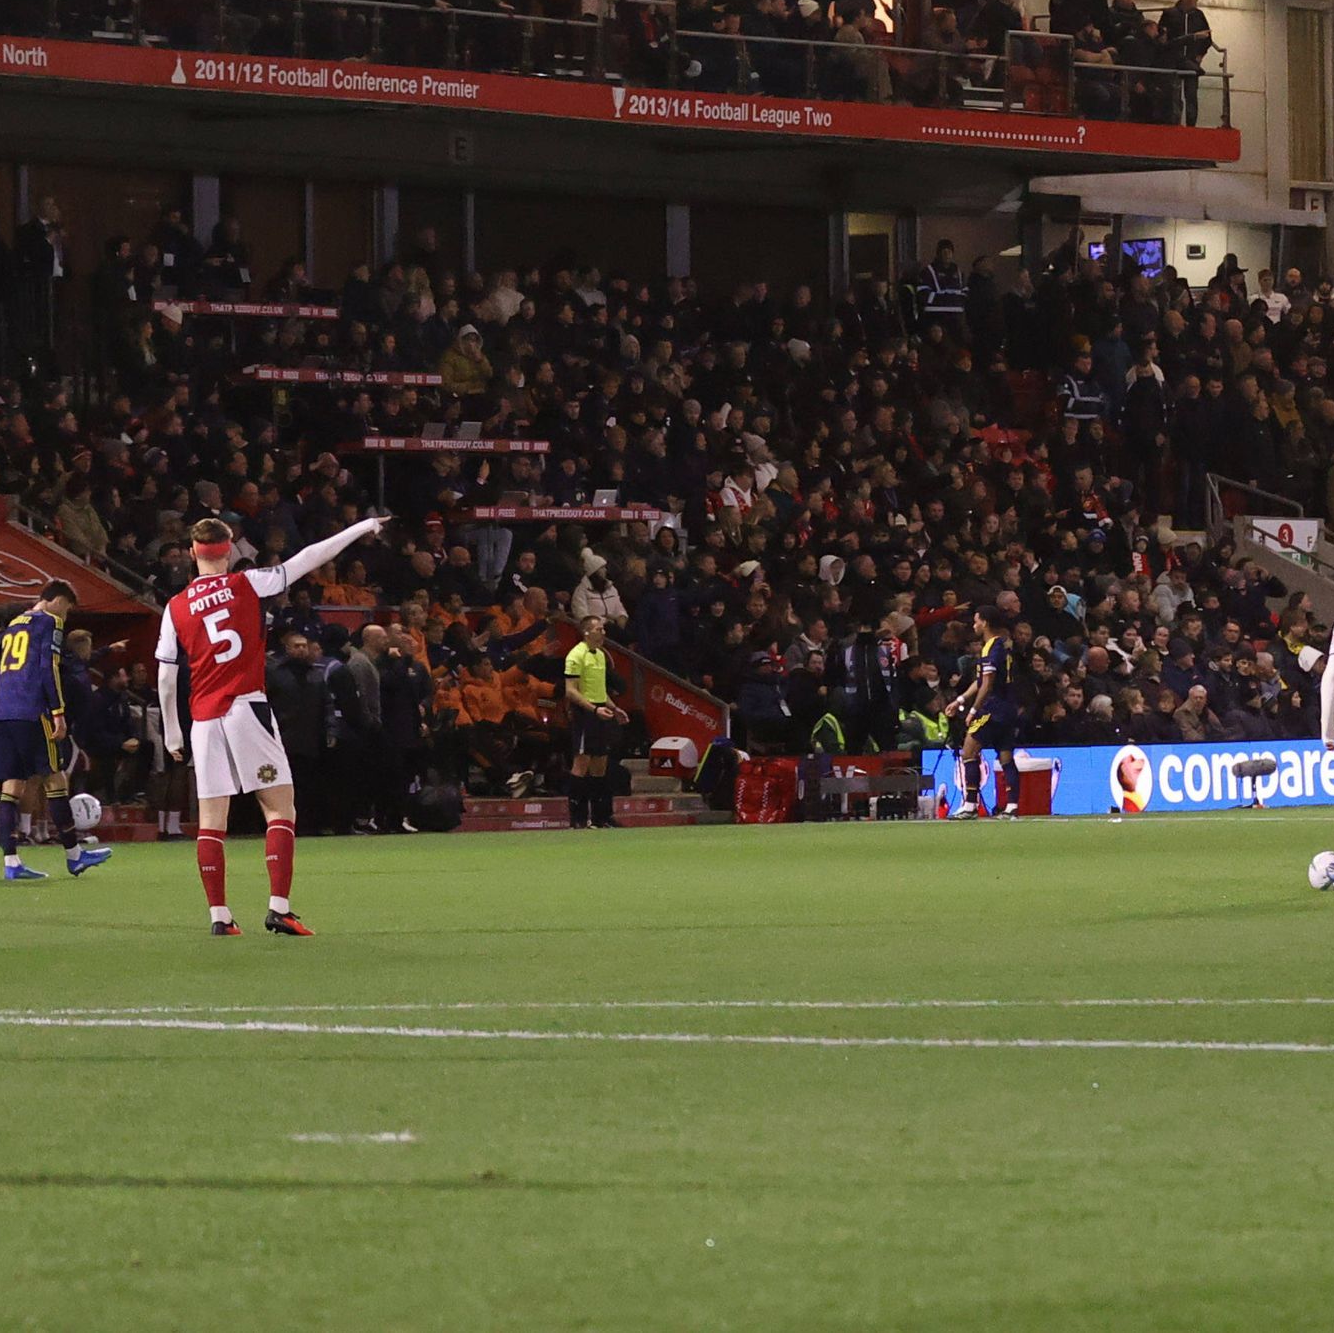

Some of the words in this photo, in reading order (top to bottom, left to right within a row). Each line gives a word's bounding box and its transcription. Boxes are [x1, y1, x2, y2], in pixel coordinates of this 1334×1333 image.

[2, 40, 47, 67] North
[194, 58, 263, 85] 2011/12
[268, 63, 328, 89] Football
[332, 68, 419, 95] Conference
[422, 75, 480, 100] Premier
[628, 94, 691, 119] 2013/14
[694, 99, 749, 123] Football
[752, 103, 801, 128] League
[803, 107, 833, 127] Two
[187, 576, 229, 599] BOXT
[189, 588, 235, 615] POTTER
[0, 630, 29, 675] 29
[203, 608, 243, 664] 5
